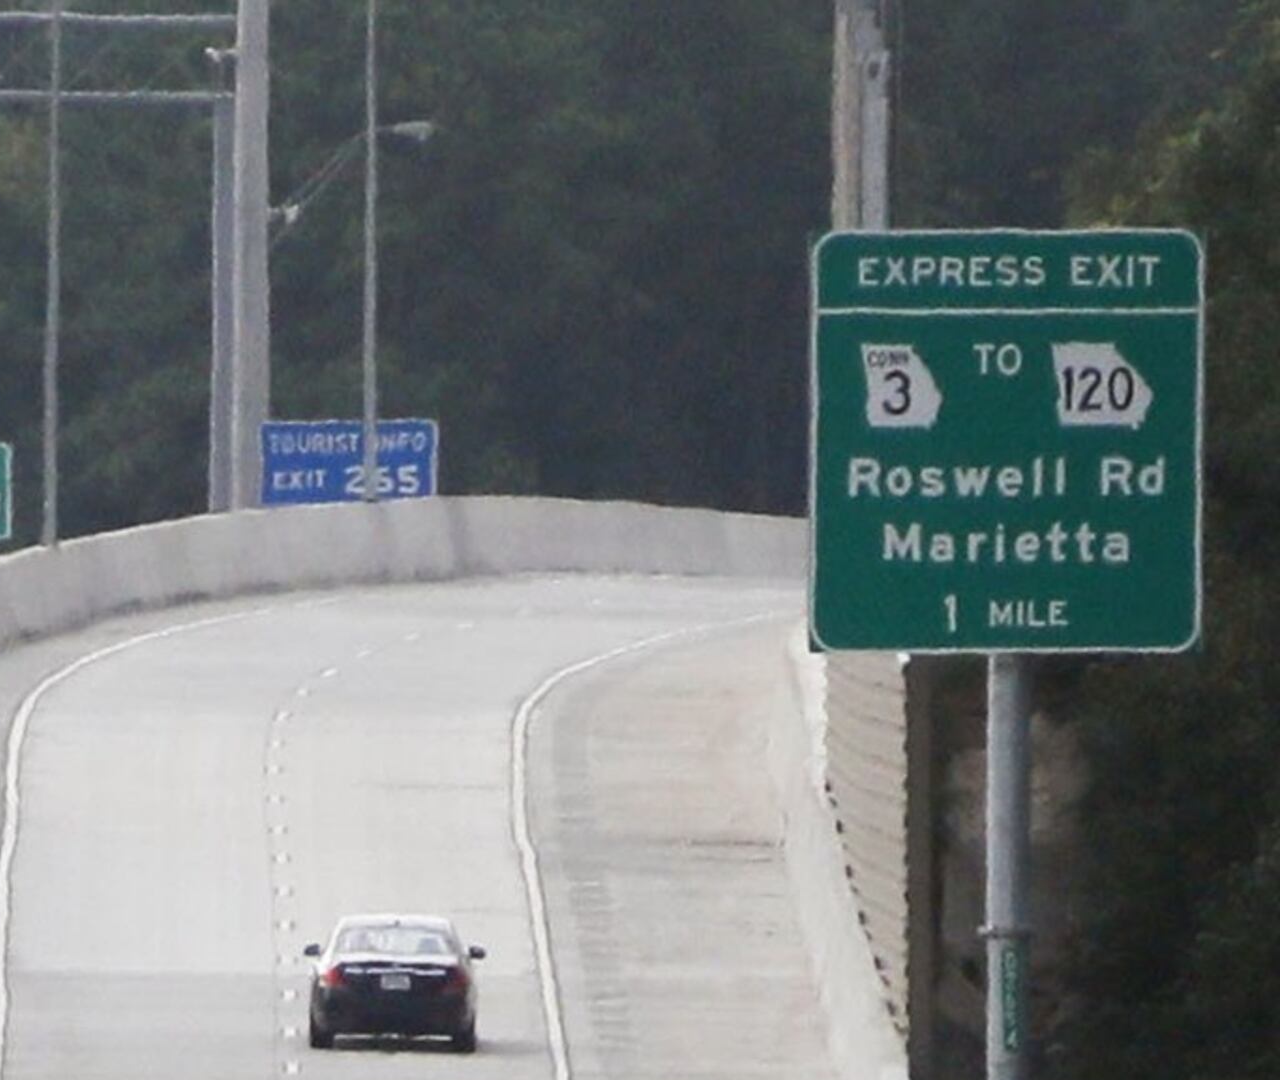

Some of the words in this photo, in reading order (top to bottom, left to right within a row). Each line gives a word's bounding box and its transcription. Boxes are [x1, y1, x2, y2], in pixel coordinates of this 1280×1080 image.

[857, 256, 1046, 288] EXPRESS
[1070, 255, 1162, 287] EXIT
[882, 369, 911, 415] 3
[974, 344, 1023, 375] TO
[1061, 366, 1135, 413] 120
[269, 432, 360, 455] TOURIST
[376, 431, 428, 453] NFO
[273, 469, 327, 491] EXIT
[848, 456, 1066, 498] Roswell
[1100, 454, 1166, 497] Rd
[882, 521, 1130, 563] Marietta
[943, 594, 958, 633] 1
[988, 600, 1069, 627] MILE
